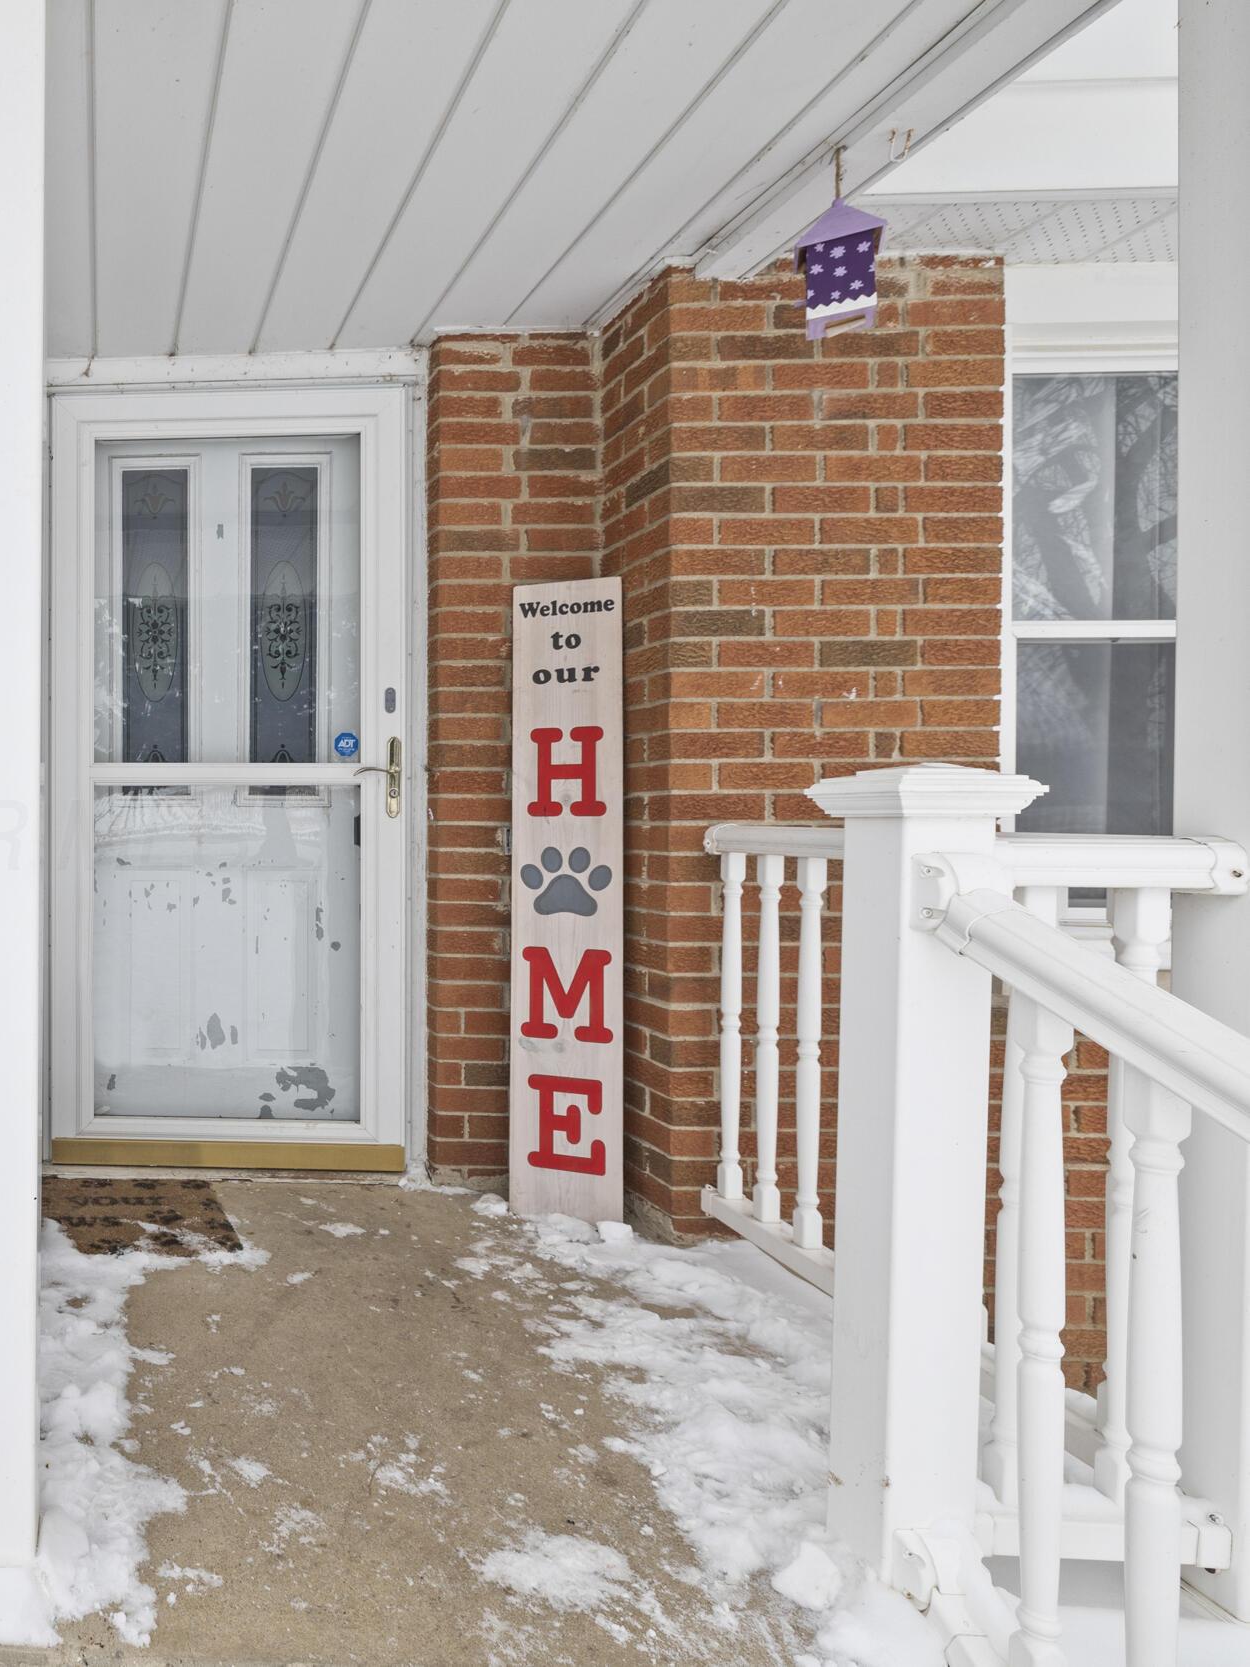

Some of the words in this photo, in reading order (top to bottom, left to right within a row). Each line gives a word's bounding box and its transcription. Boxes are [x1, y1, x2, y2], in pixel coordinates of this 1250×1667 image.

[519, 599, 615, 618] Welcome
[551, 631, 581, 650] to
[532, 665, 600, 685] our
[338, 739, 356, 748] ADT
